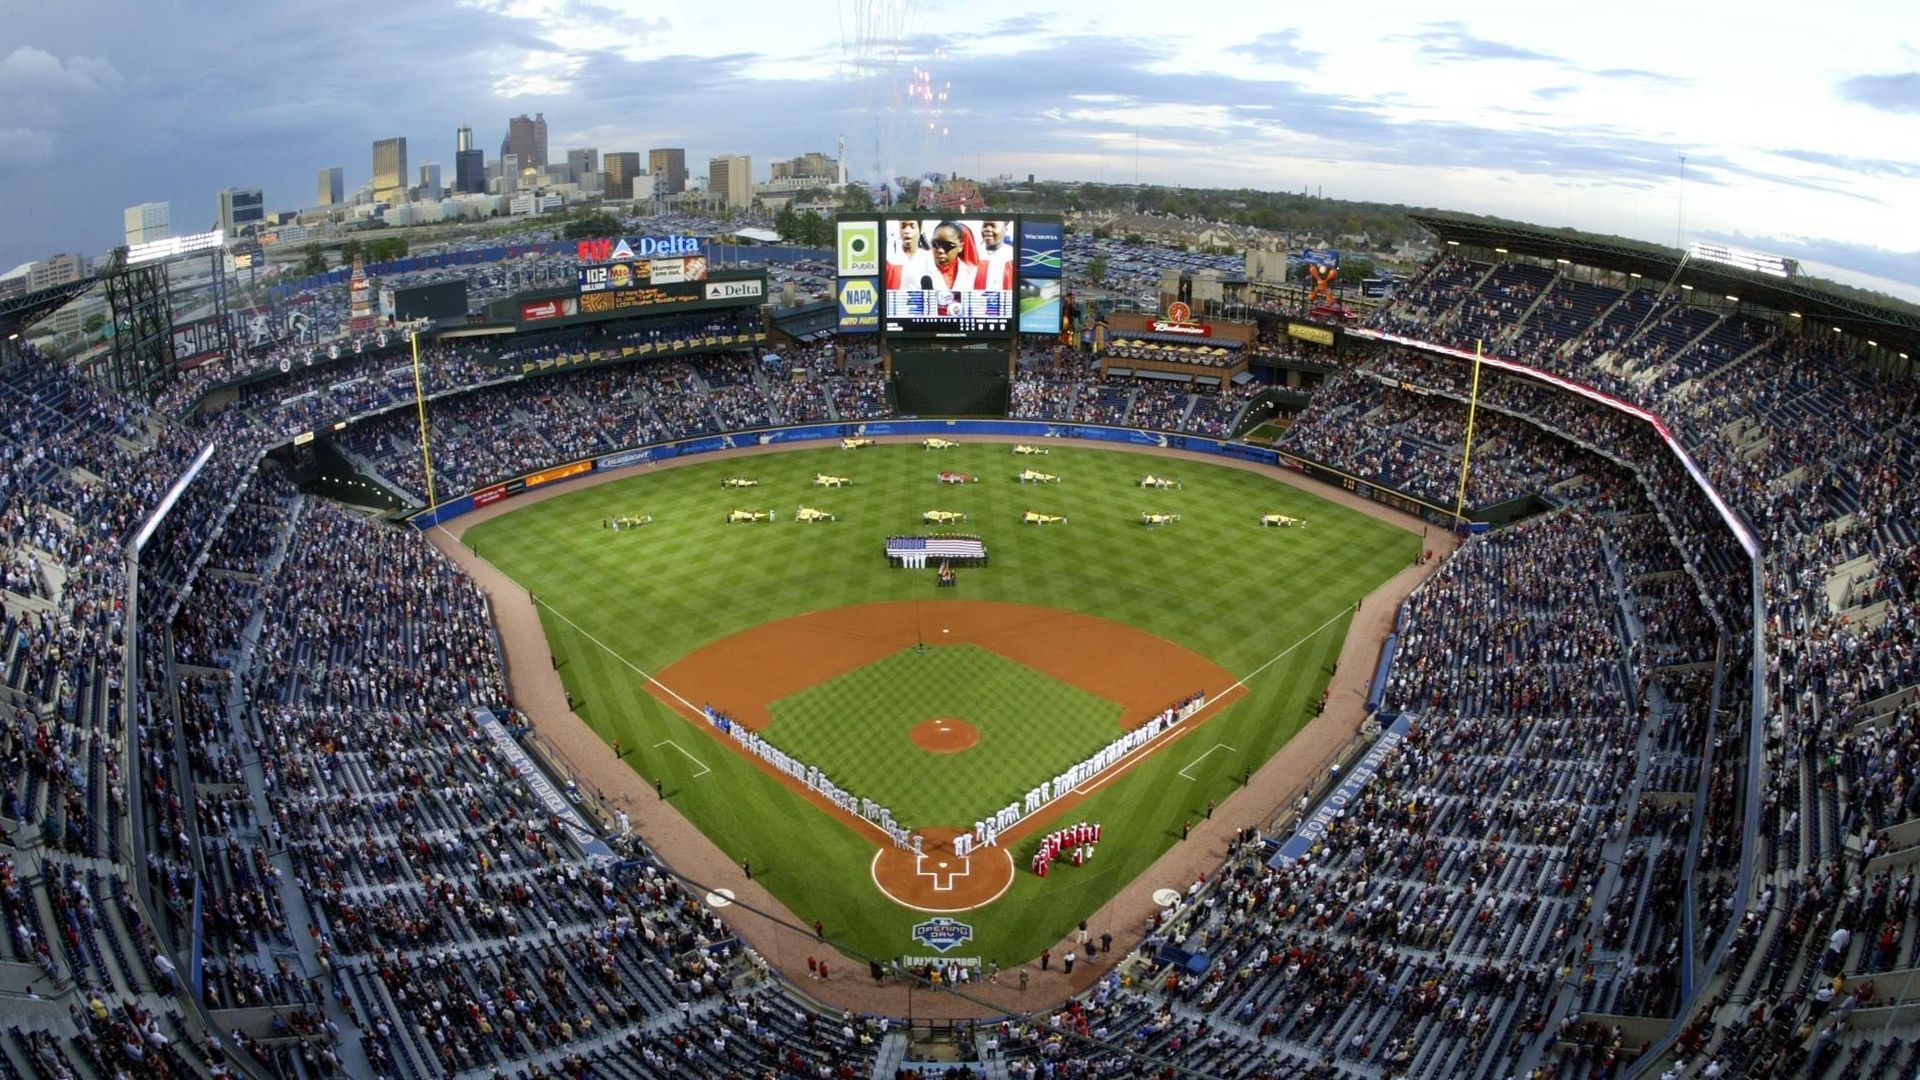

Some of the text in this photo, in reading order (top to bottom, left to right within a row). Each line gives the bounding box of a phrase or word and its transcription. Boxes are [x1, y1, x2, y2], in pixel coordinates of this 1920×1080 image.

[578, 235, 699, 262] FLY Delta
[653, 264, 681, 272] Hammer
[851, 262, 875, 270] Publix
[587, 268, 607, 283] 102
[725, 284, 759, 296] Delta
[846, 290, 872, 304] NAPA
[1152, 322, 1204, 334] Budweiser
[1299, 806, 1337, 841] HOME
[1345, 766, 1373, 789] THE
[1364, 731, 1401, 767] BRAVES
[917, 925, 968, 935] OPENING
